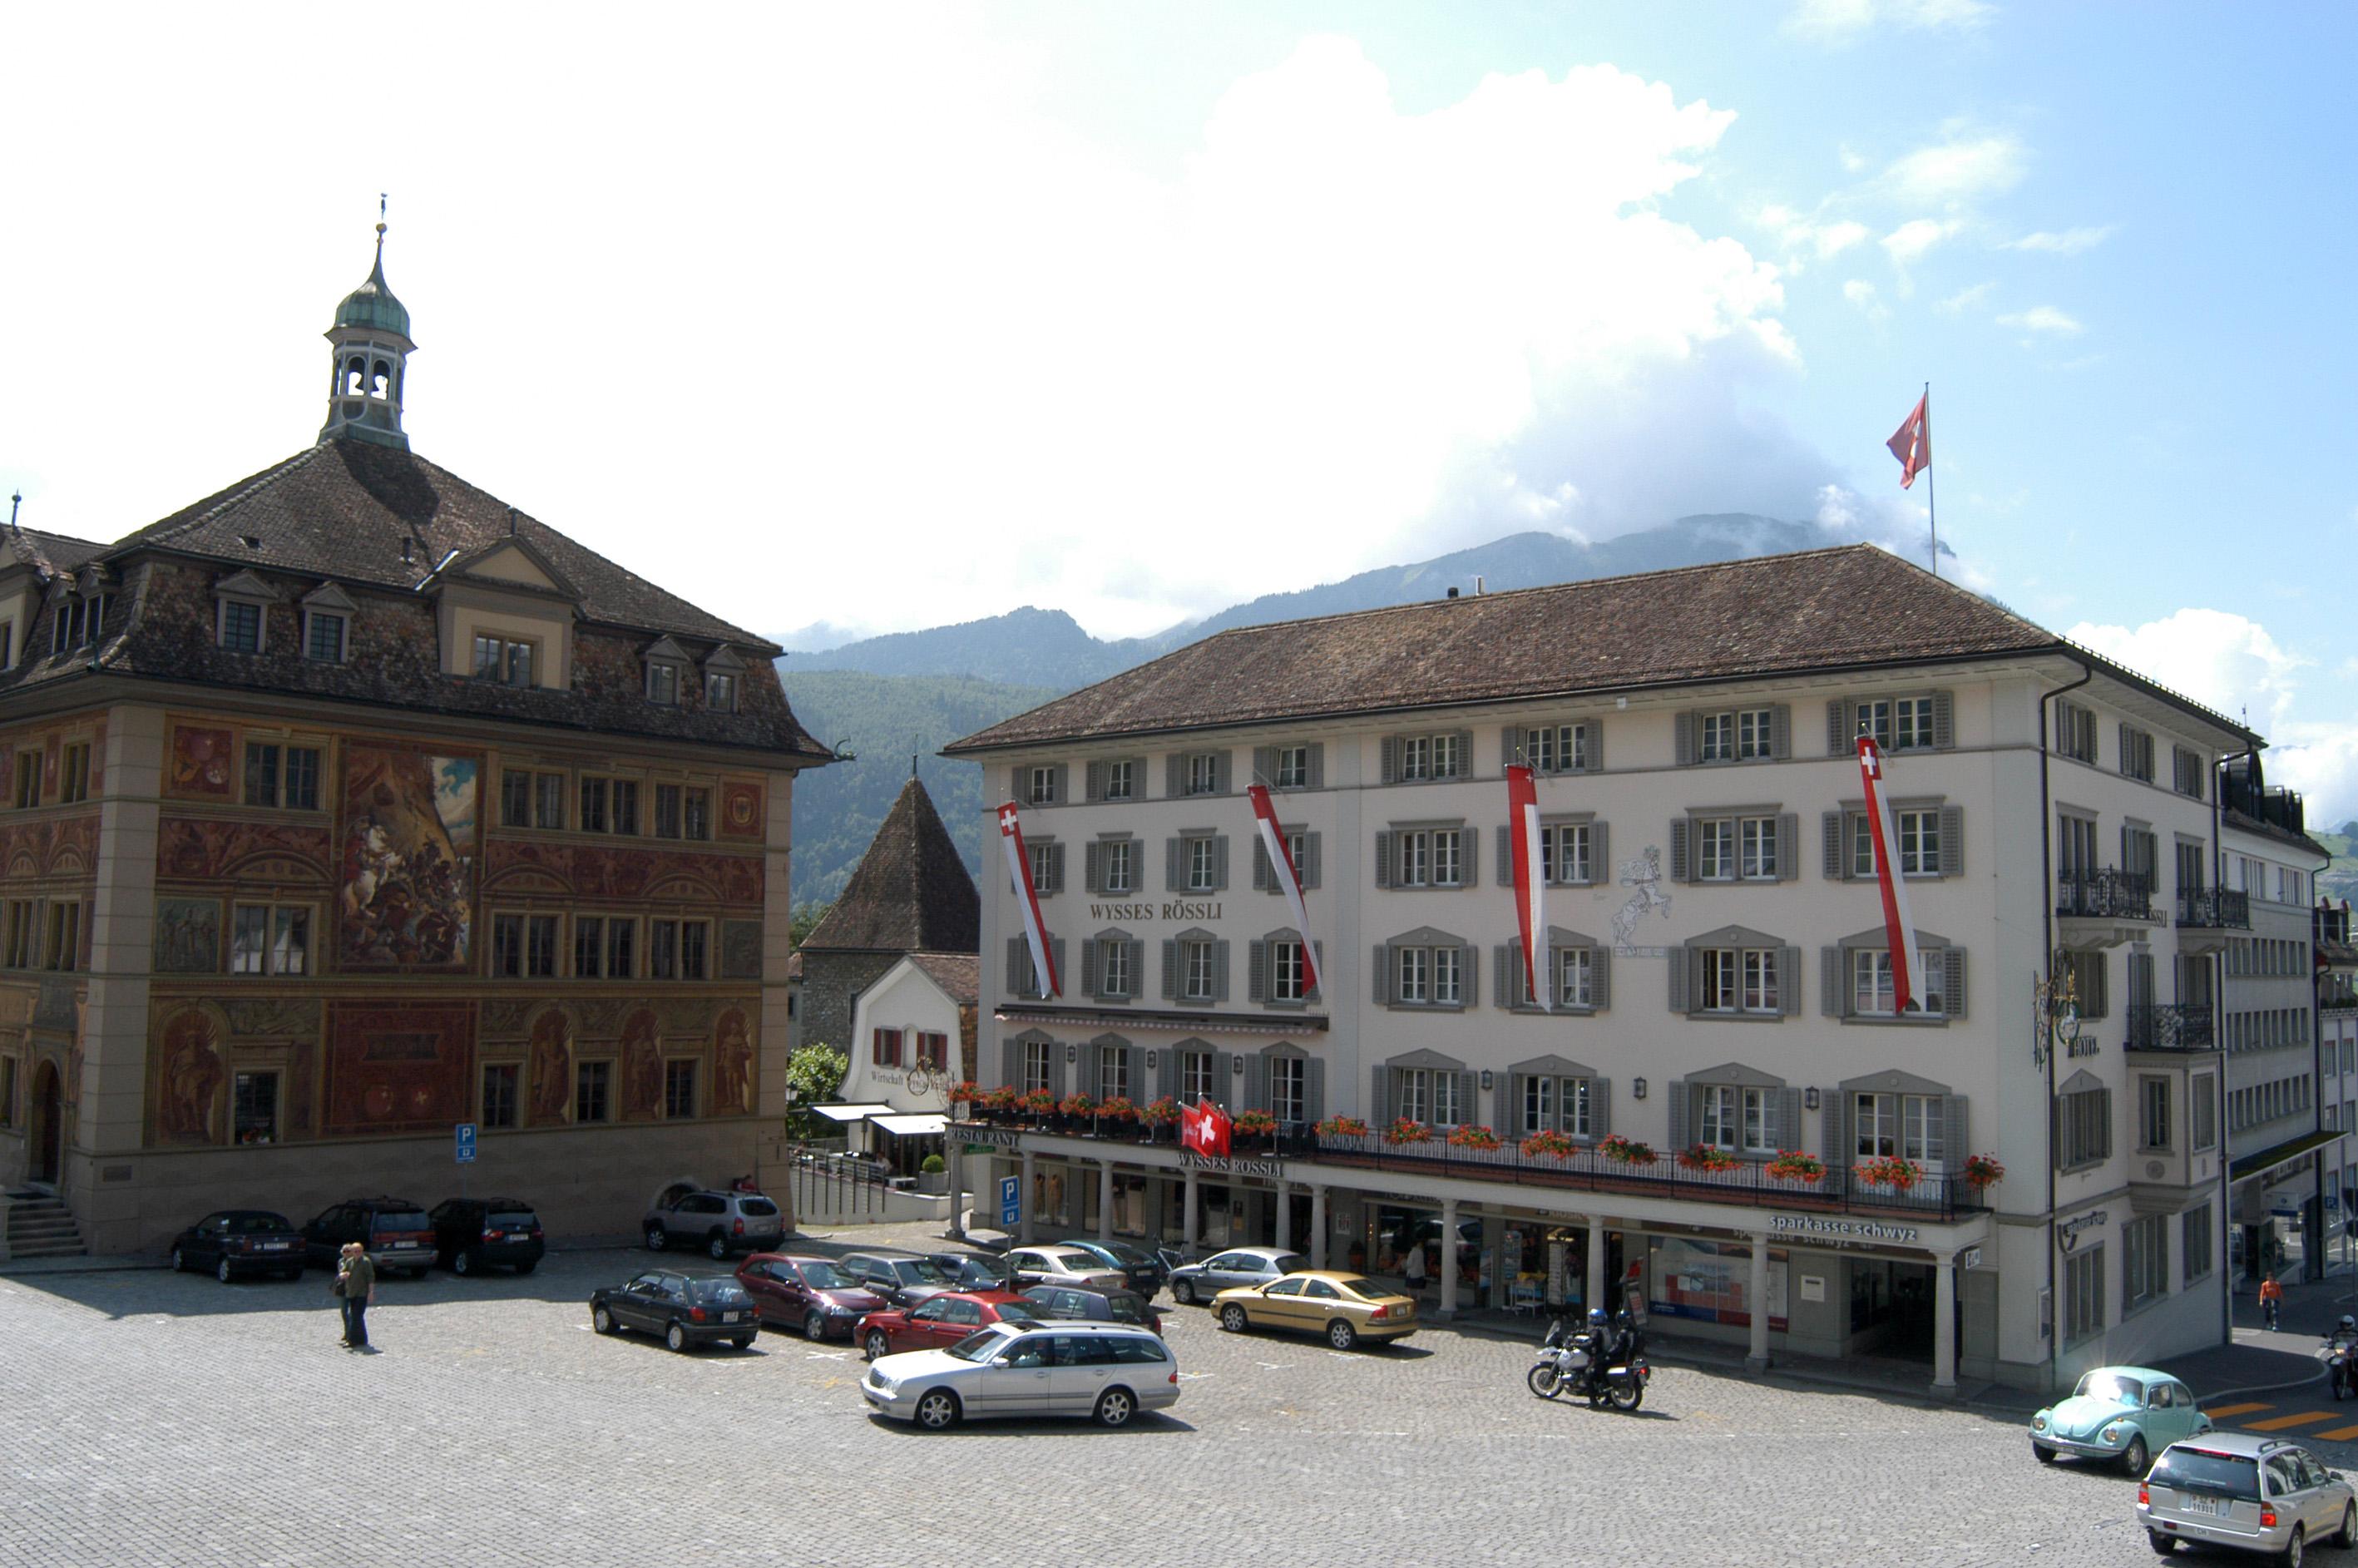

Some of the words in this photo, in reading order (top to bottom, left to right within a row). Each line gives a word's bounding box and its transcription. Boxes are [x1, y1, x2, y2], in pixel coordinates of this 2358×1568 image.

[1090, 903, 1154, 920] WYSSES
[1161, 899, 1223, 920] RÖSSLI
[462, 1127, 472, 1142] P
[951, 1127, 1018, 1147] RESTAURANT
[1177, 1153, 1229, 1170] WYSSES
[1006, 1182, 1015, 1200] P
[1769, 1215, 1850, 1234] sparkasse
[1855, 1223, 1917, 1243] schwyz
